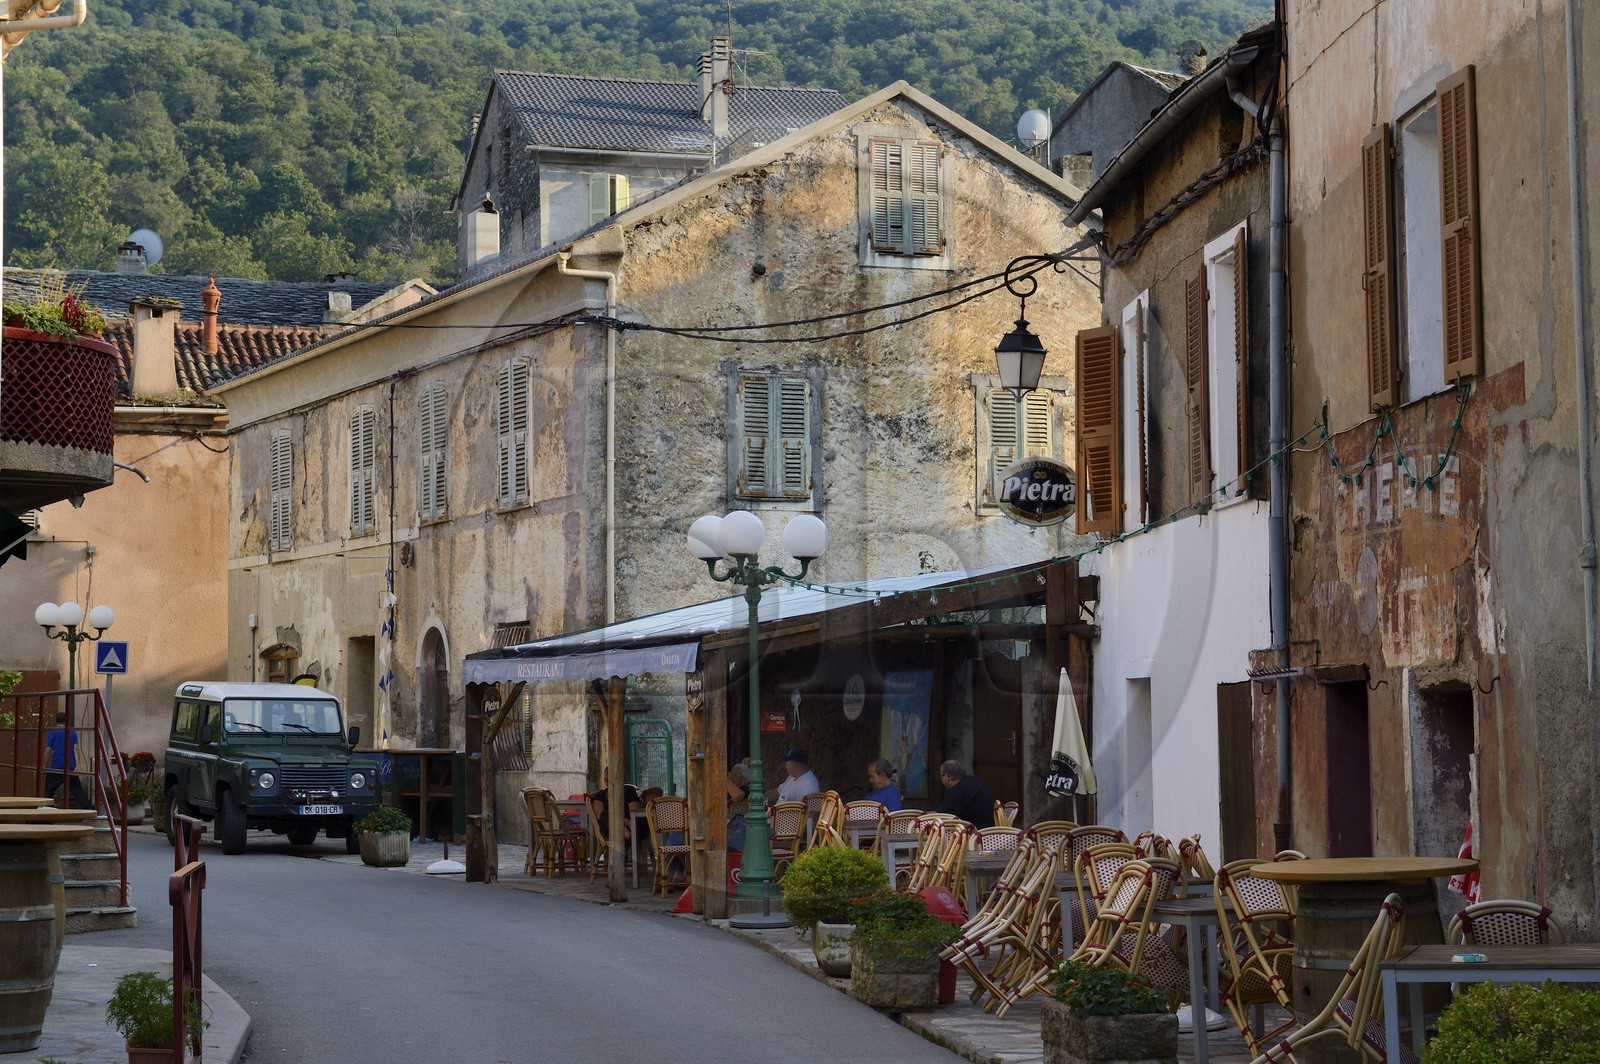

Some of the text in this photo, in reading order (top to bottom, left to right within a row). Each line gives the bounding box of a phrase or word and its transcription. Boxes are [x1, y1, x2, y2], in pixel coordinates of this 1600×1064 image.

[1020, 461, 1059, 470] BRASSERIE
[1001, 476, 1075, 502] Pietra
[517, 663, 566, 678] RESTAURANT
[687, 678, 702, 692] Pietra
[485, 700, 500, 712] Pietra
[1057, 753, 1077, 769] CORSA
